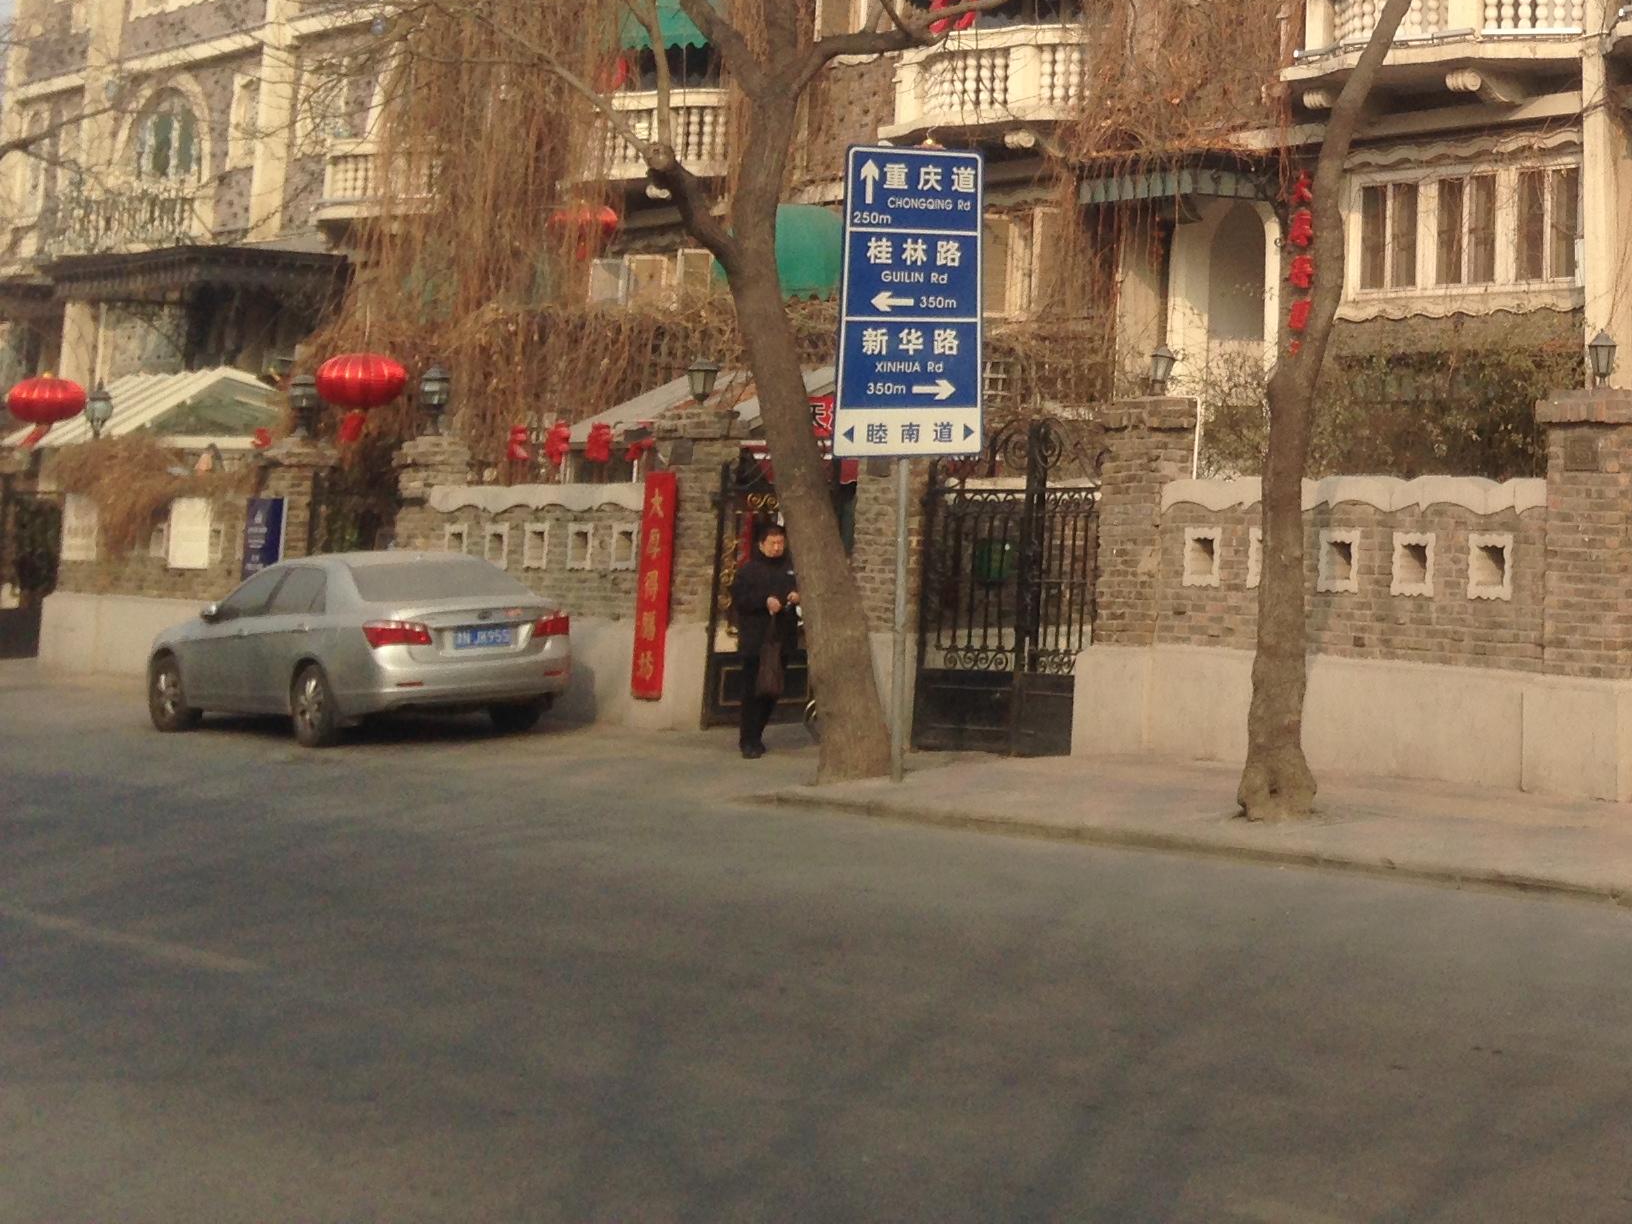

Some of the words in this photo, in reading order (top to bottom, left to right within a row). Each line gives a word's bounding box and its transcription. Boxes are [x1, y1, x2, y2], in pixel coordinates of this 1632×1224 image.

[883, 163, 976, 193] 重庆道
[887, 197, 953, 211] CHONGQING
[957, 199, 971, 211] Rd
[853, 211, 892, 225] 250m
[866, 237, 961, 267] 桂林路
[881, 270, 924, 283] GUILIN
[930, 272, 948, 284] Rd
[919, 296, 957, 309] 350m
[862, 328, 959, 356] 新华路
[875, 361, 921, 373] XINHUA
[927, 361, 944, 373] Rd
[866, 382, 906, 395] 350m
[866, 421, 953, 445] 睦南道
